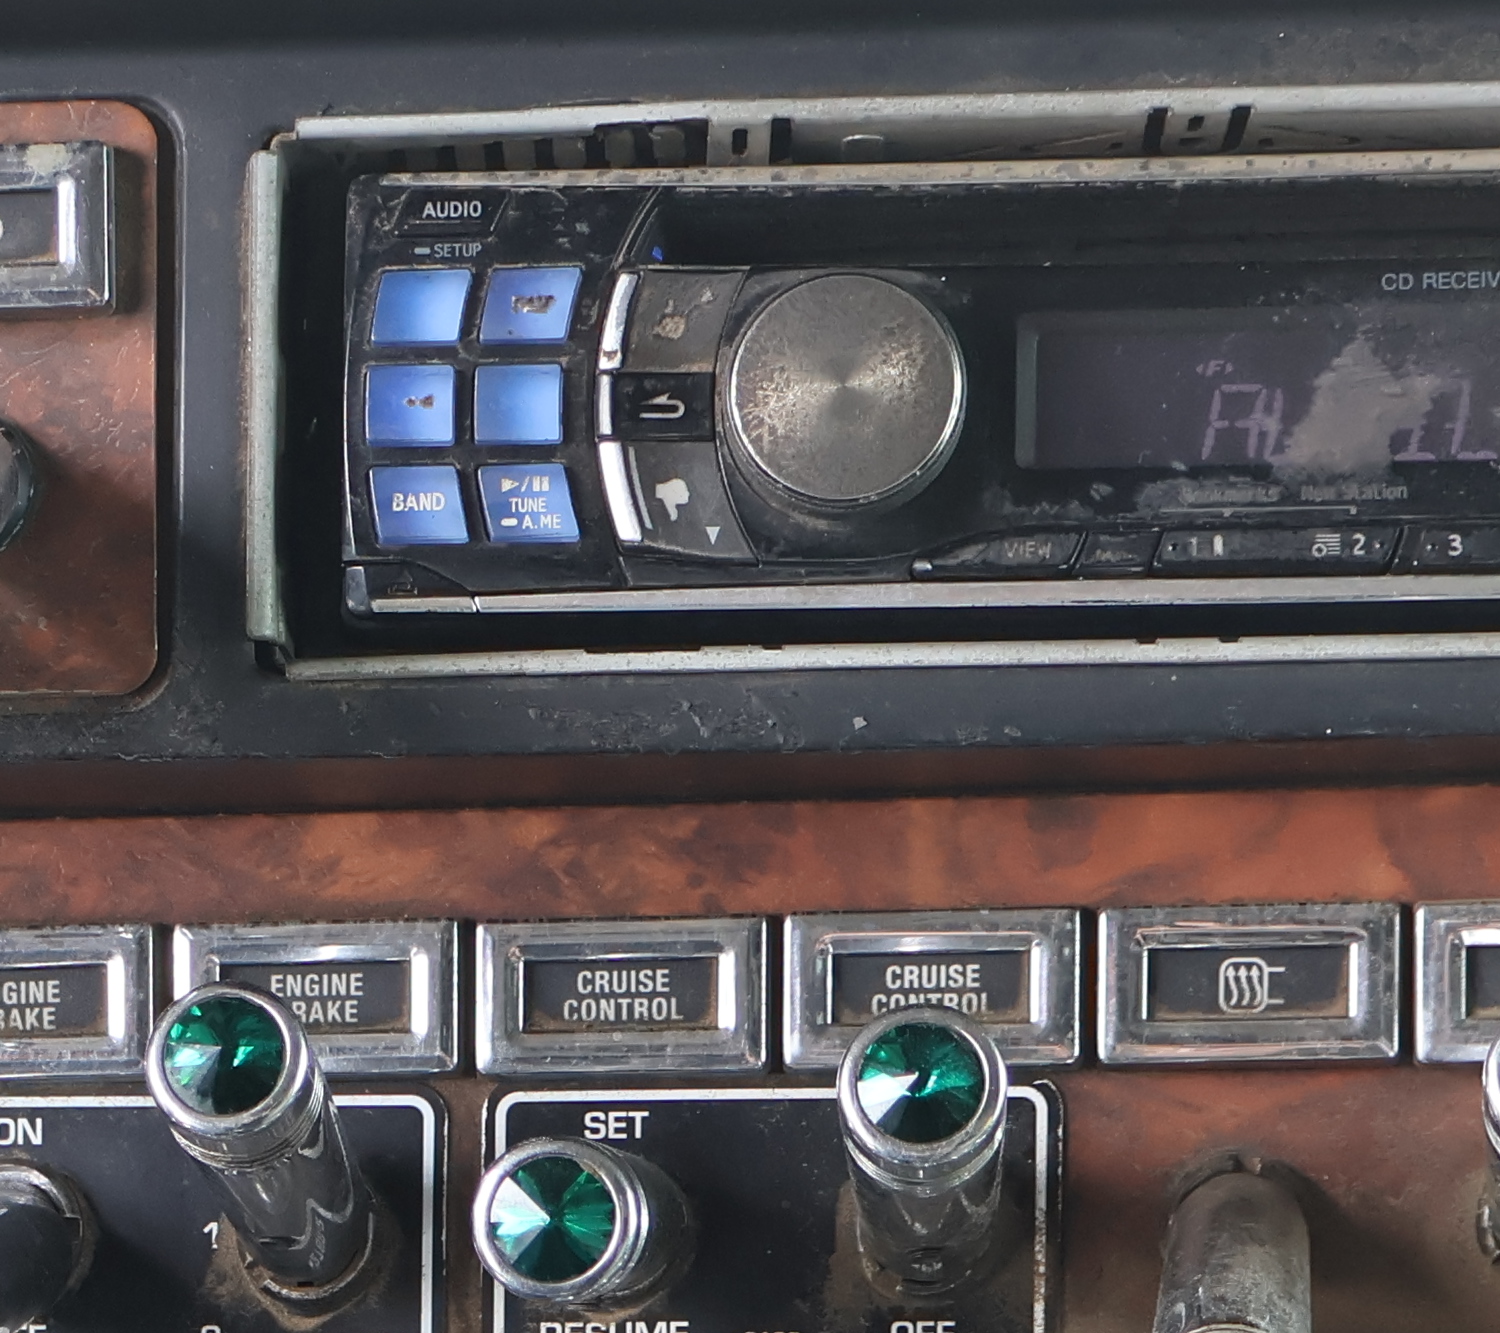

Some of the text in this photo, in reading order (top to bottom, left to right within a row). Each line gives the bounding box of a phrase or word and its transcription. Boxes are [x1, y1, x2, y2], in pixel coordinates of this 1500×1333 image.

[423, 201, 483, 219] AUDIO
[433, 243, 482, 258] SETUP
[1381, 273, 1413, 290] CD
[392, 493, 446, 511] BAND
[509, 498, 547, 512] TUNE
[1005, 541, 1052, 560] VIEW
[269, 973, 364, 1000] ENGINE
[576, 968, 670, 996] CRUISE
[885, 964, 981, 992] CRUISE
[291, 999, 360, 1024] RAKE
[562, 994, 685, 1022] CONTROL
[583, 1112, 649, 1141] SET
